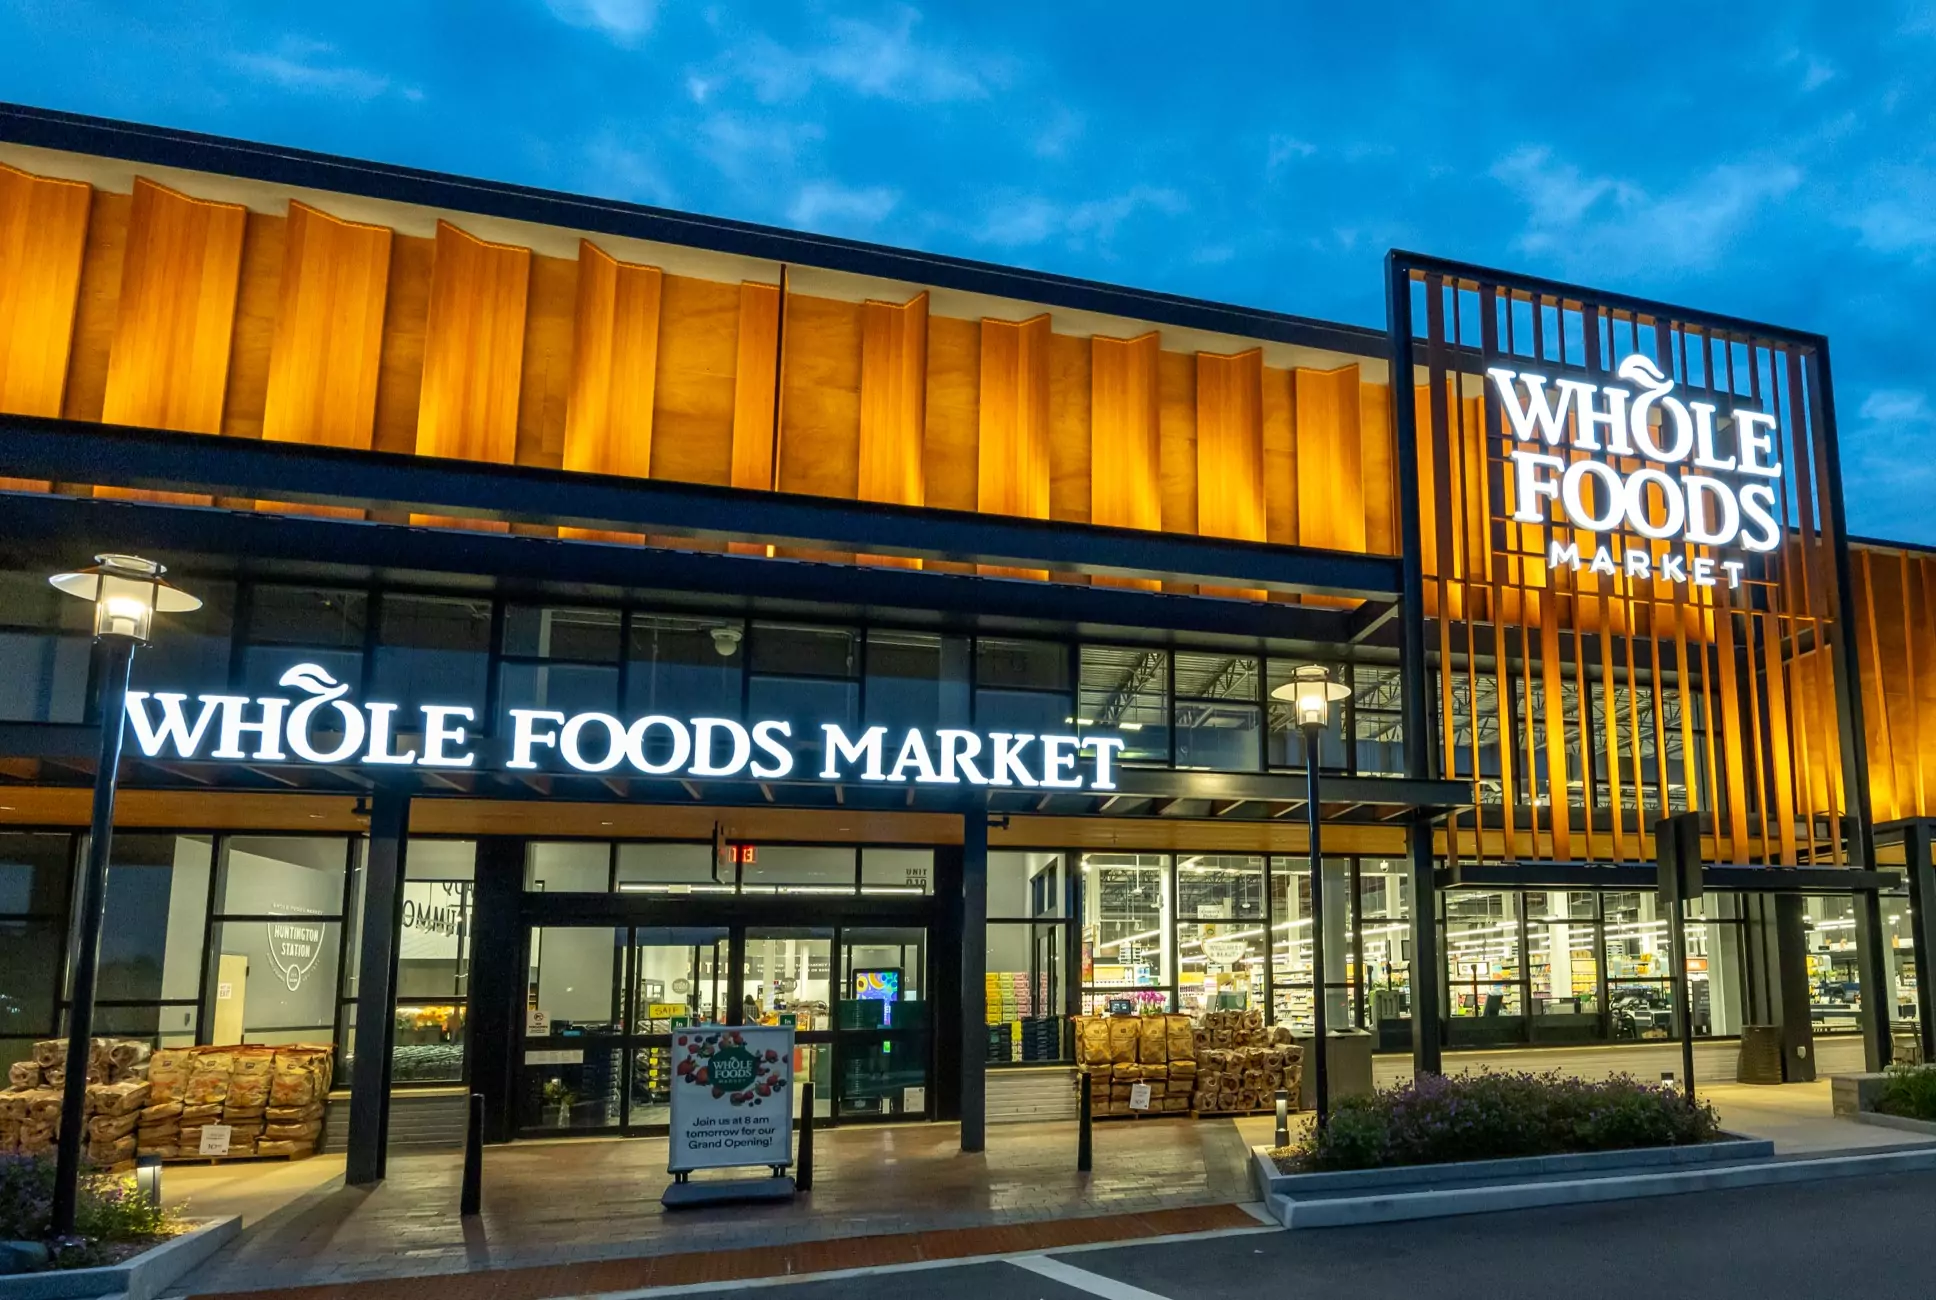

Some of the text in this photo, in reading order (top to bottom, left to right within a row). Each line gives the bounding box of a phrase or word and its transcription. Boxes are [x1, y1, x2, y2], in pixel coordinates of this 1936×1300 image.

[1487, 354, 1782, 478] WHOLE
[1510, 451, 1782, 553] FOODS
[1548, 541, 1744, 589] MARKET
[125, 663, 1125, 790] WHOLE FOODS MARKET
[905, 868, 927, 876] UNIT
[274, 924, 319, 942] HUNTINGTON
[281, 942, 311, 957] STATION
[713, 1056, 753, 1070] WHOLE
[714, 1069, 752, 1079] FOODS
[692, 1116, 769, 1127] Join us at 8 am
[686, 1127, 775, 1138] tomorrow for our
[688, 1136, 773, 1150] Grand Opening!
